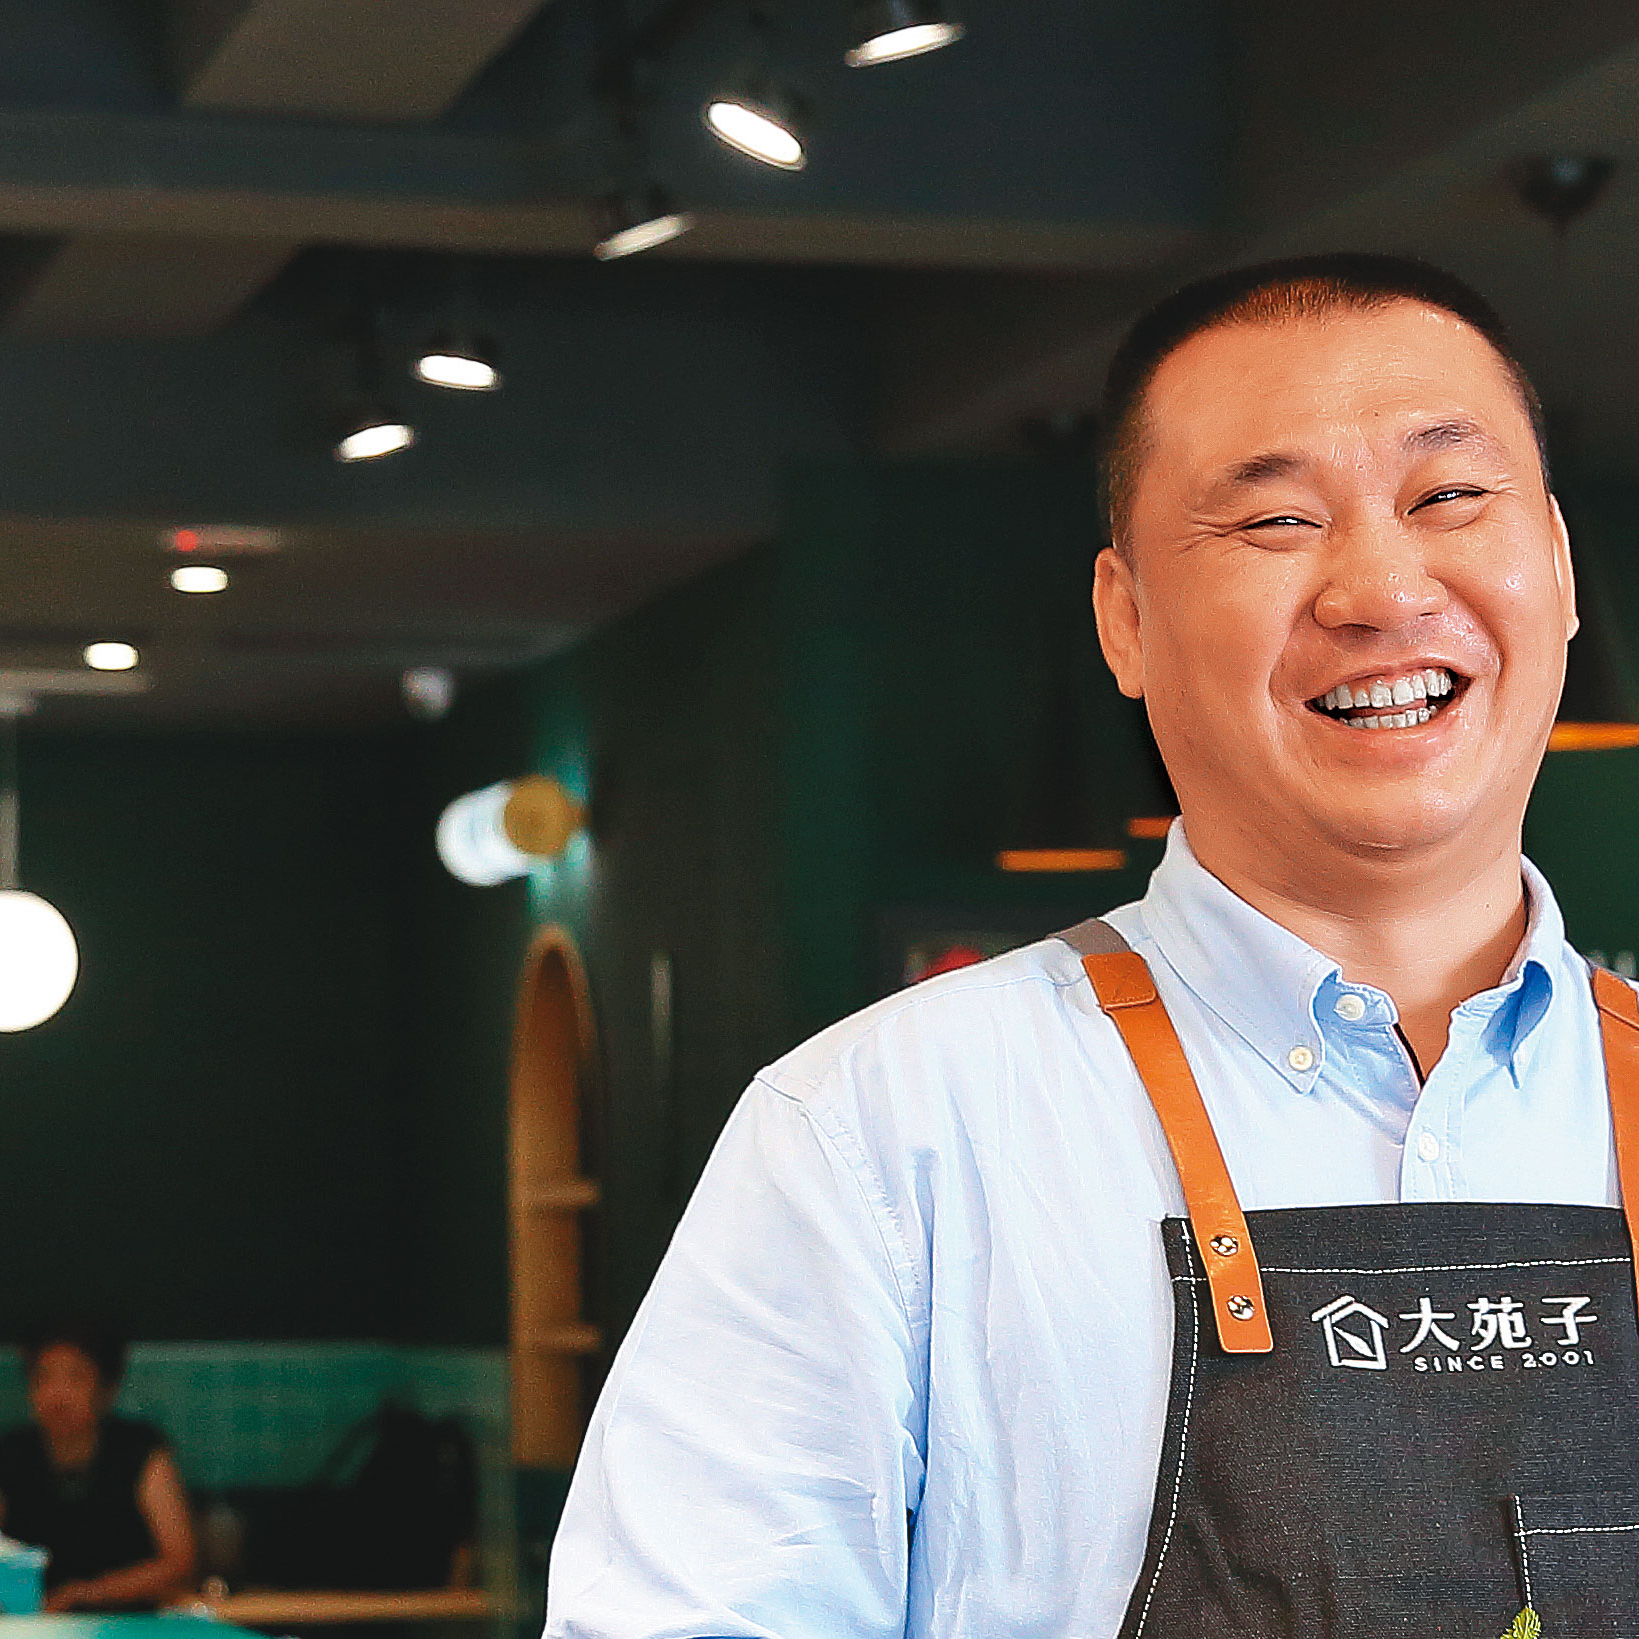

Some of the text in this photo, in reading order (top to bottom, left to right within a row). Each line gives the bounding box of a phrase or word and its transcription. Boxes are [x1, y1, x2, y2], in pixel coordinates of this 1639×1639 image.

[1398, 1296, 1599, 1354] 大苑子
[1413, 1350, 1595, 1372] SINCE 2001
